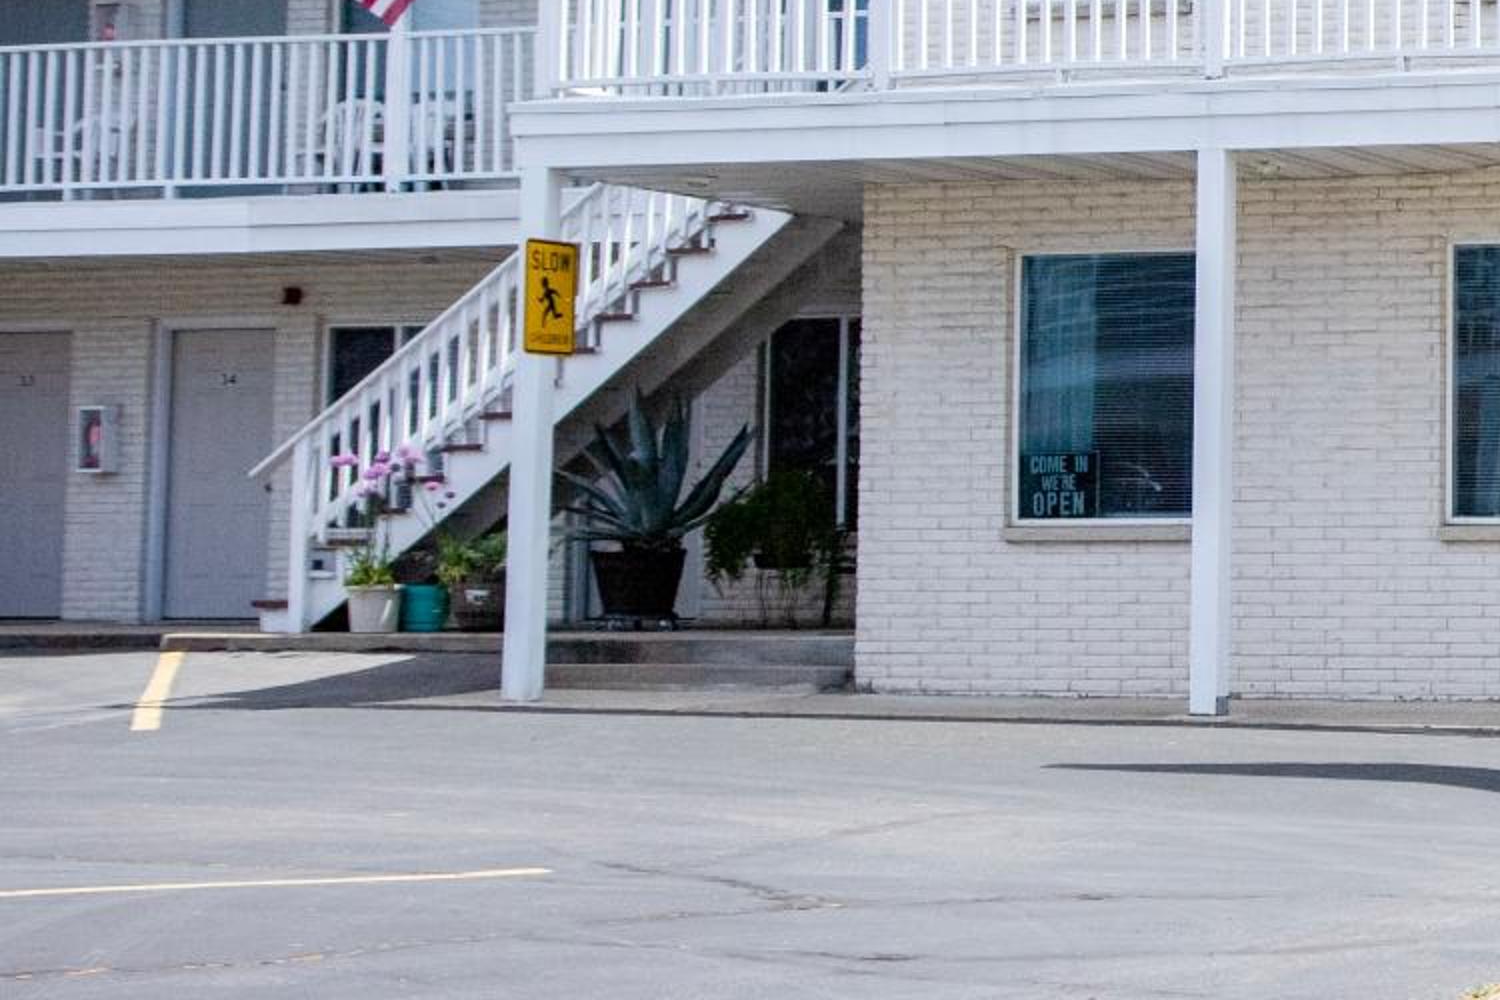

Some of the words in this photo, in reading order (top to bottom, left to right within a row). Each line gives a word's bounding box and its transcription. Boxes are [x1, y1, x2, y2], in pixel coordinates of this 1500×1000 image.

[532, 248, 571, 273] SLOW
[1029, 454, 1070, 474] COME
[1074, 455, 1089, 473] IN
[1032, 490, 1085, 517] OPEN
